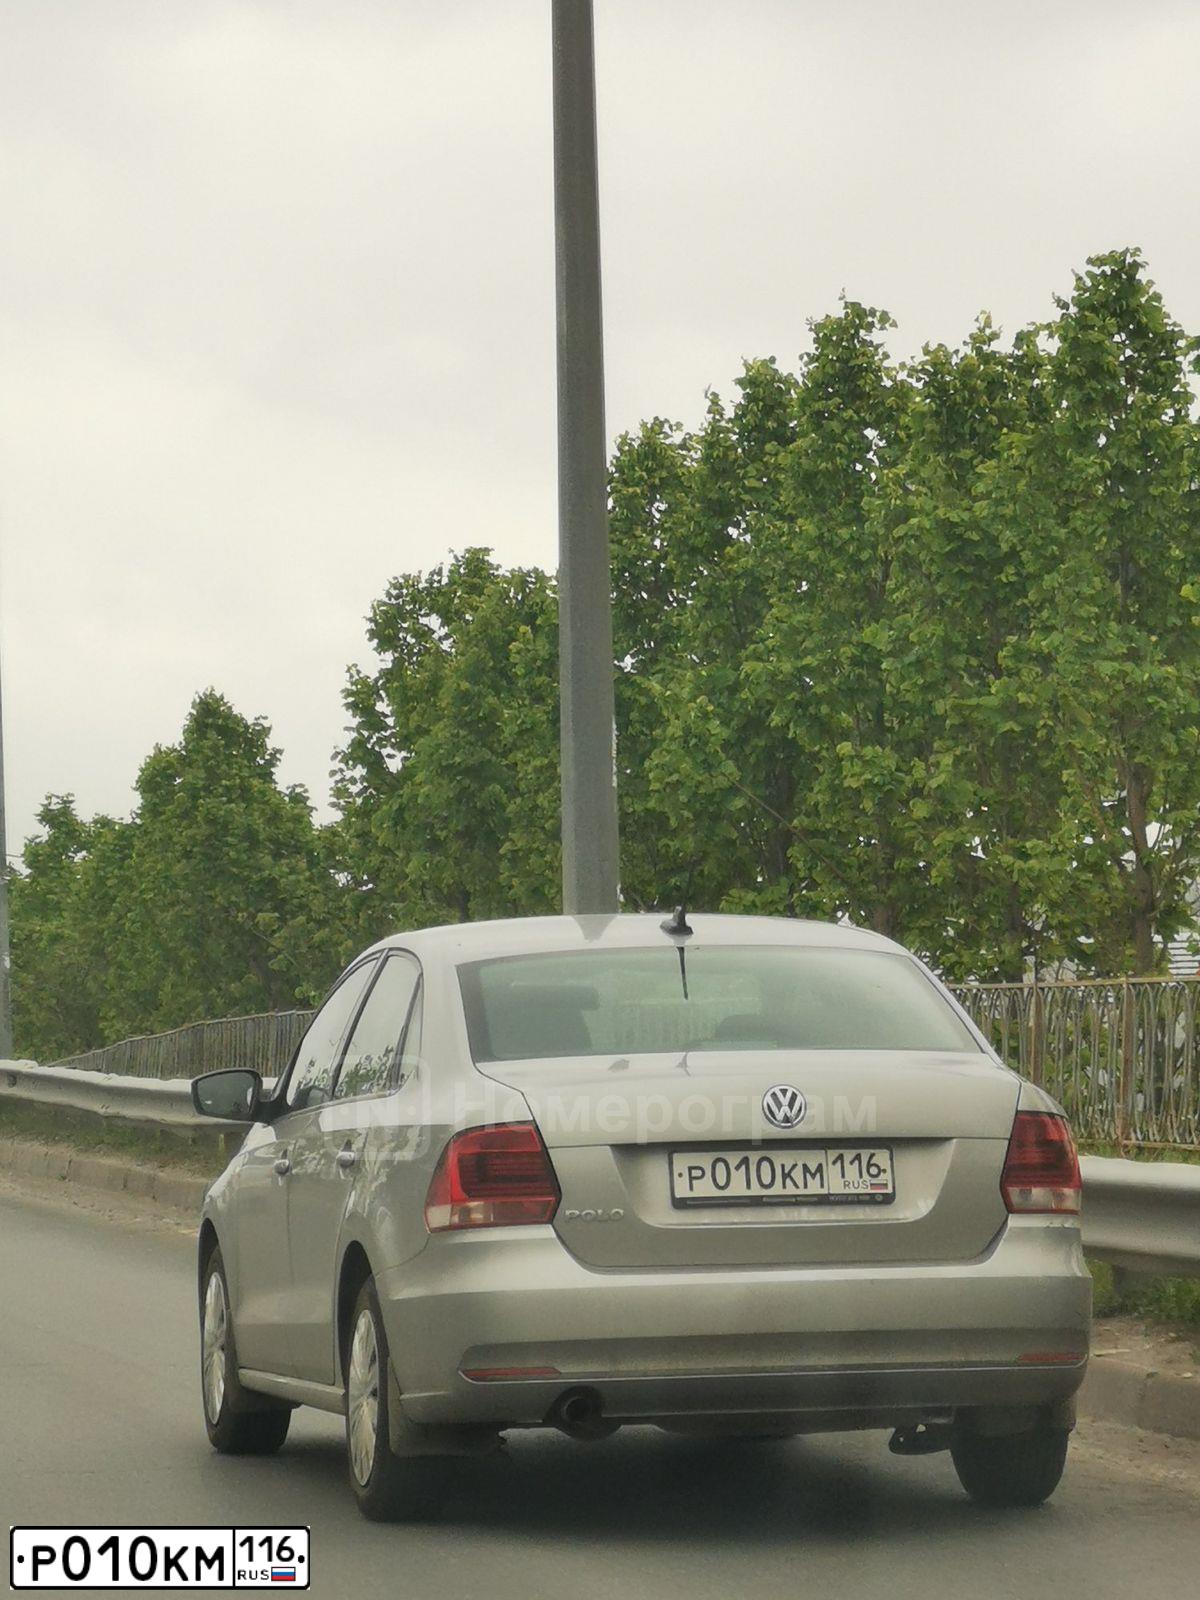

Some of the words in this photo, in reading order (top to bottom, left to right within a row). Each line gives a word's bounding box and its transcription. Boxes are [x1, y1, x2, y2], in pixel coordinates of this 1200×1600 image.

[831, 1152, 882, 1179] 116
[843, 1179, 869, 1190] RUS
[564, 1207, 625, 1222] POLO
